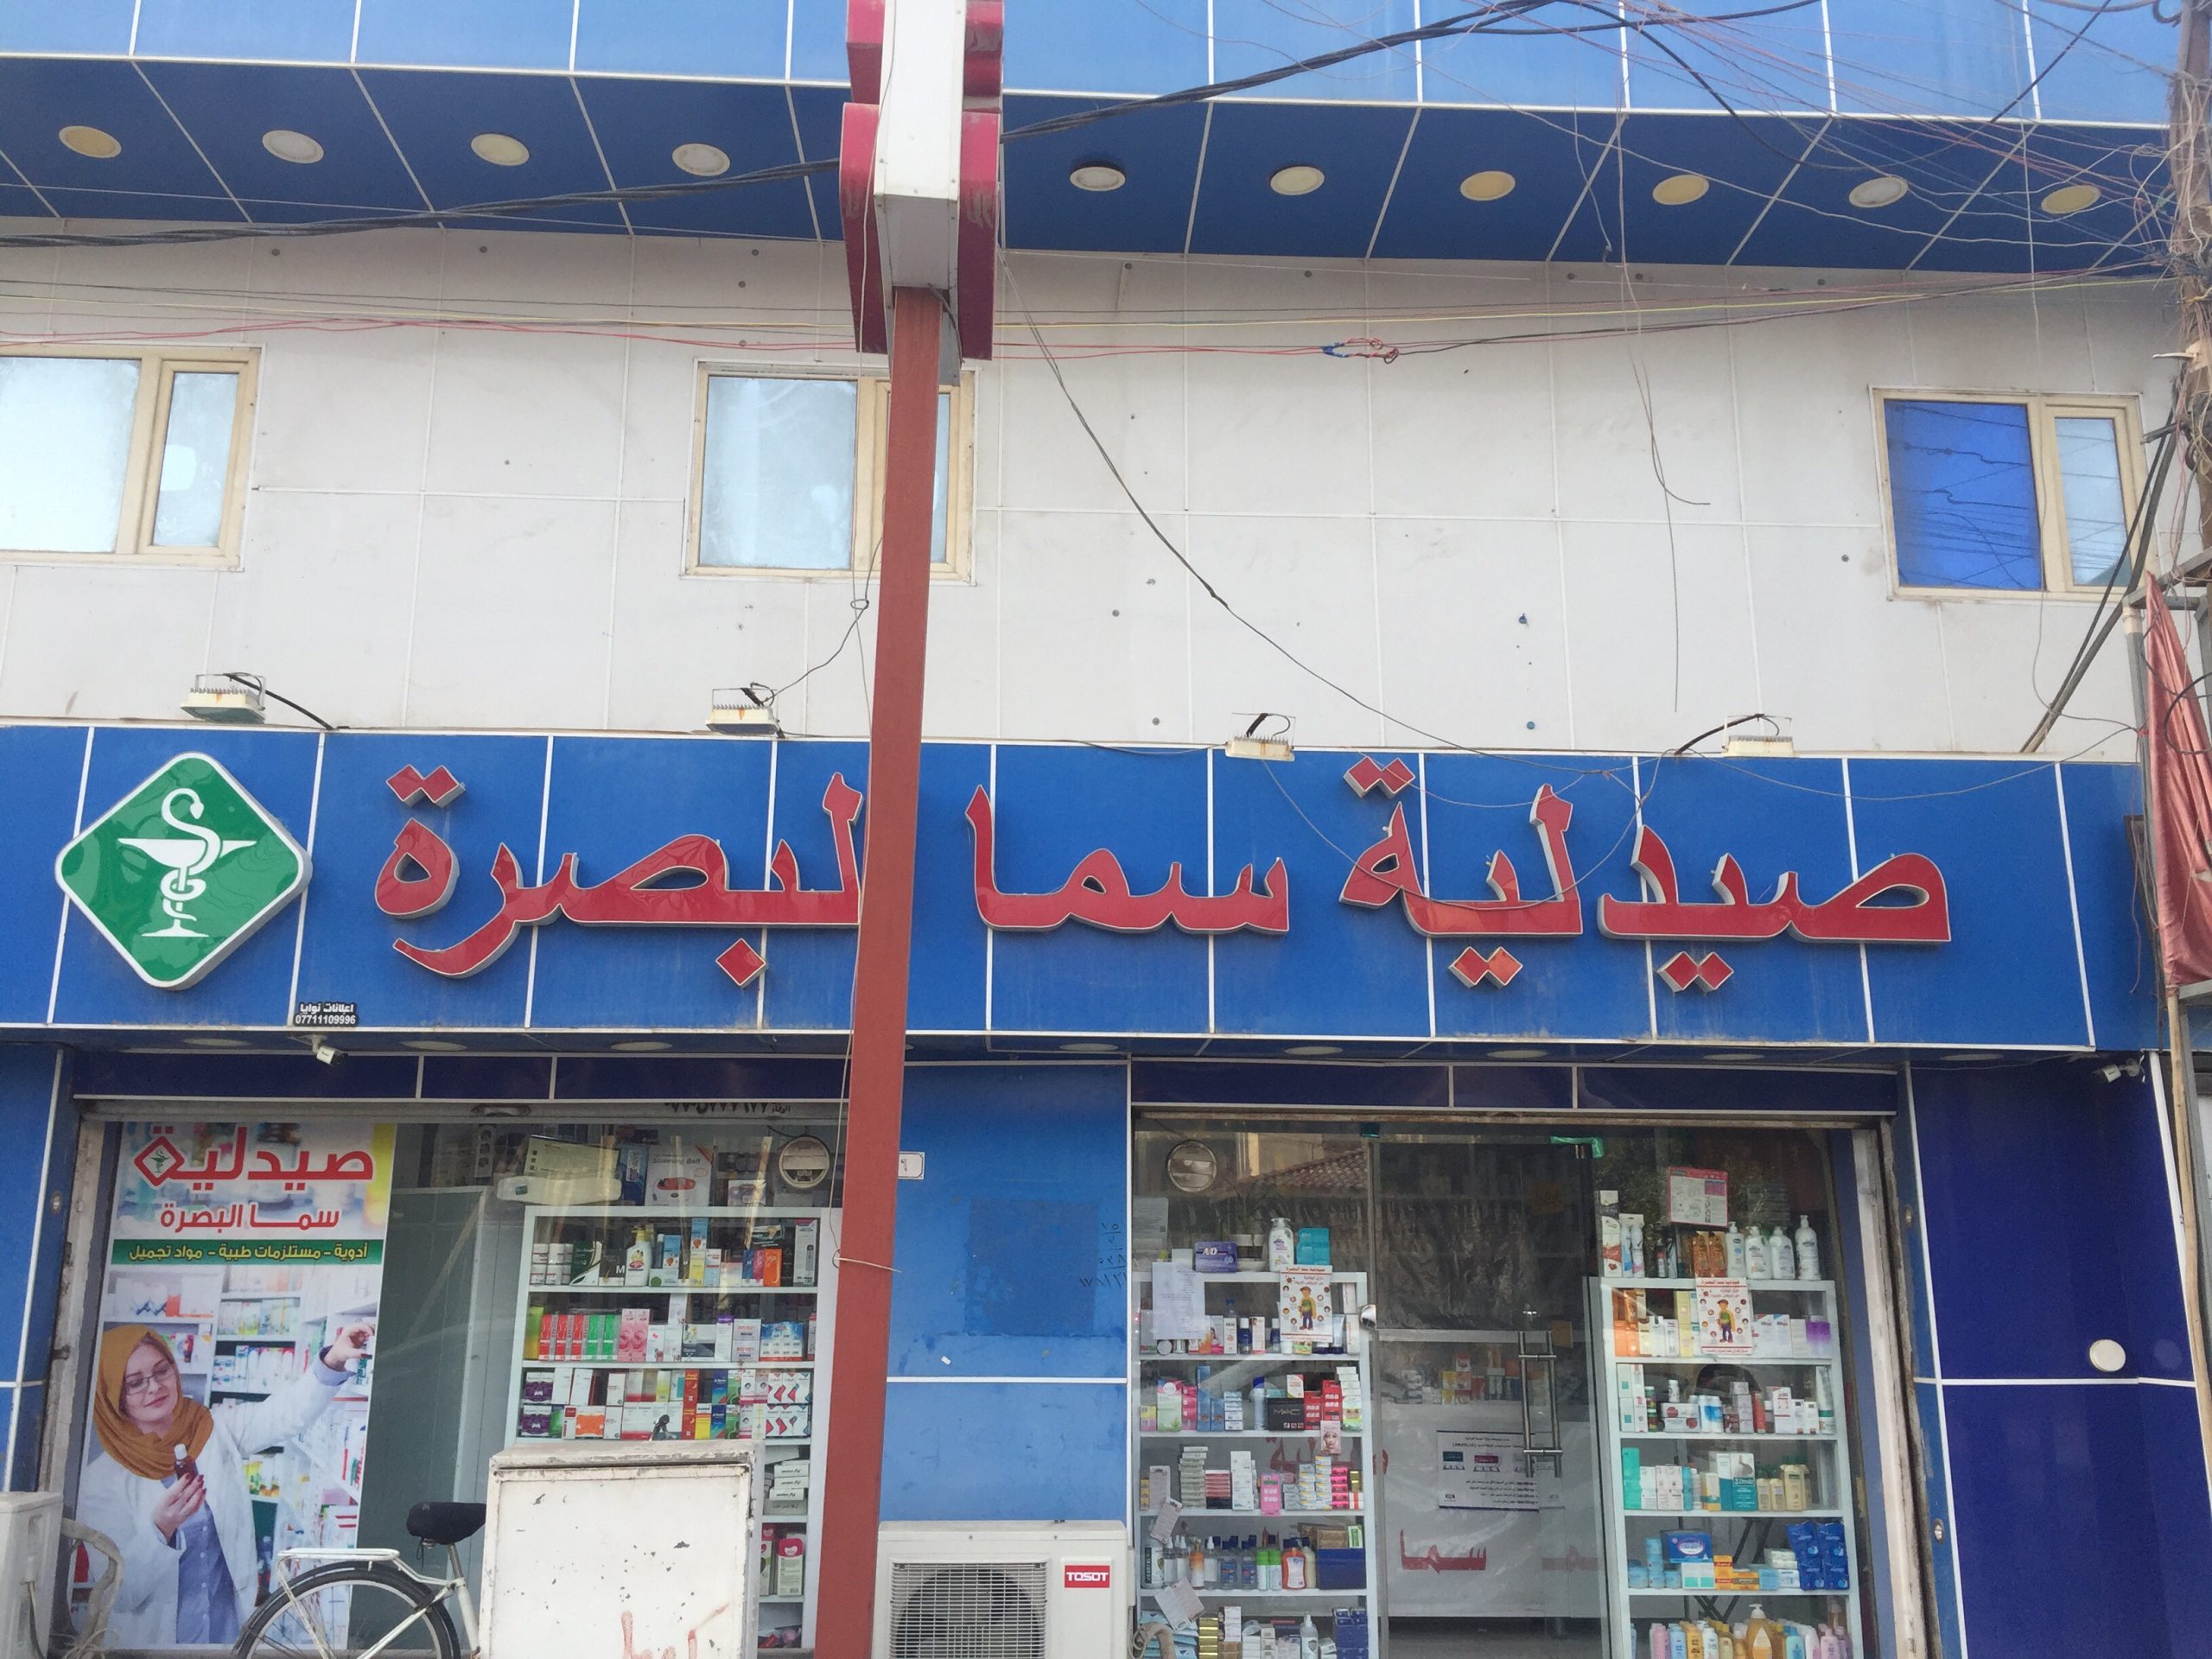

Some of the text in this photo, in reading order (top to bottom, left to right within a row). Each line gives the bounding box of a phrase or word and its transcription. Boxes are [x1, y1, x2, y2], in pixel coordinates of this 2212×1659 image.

[375, 757, 1951, 993] صيدلية سما لبصرة
[296, 1014, 356, 1025] 07711109996
[134, 1126, 373, 1191] صيدلية
[160, 1203, 340, 1233] سما البصرة
[129, 1243, 172, 1261] تجميل
[175, 1245, 203, 1261] مواد
[219, 1243, 251, 1261] طبية
[254, 1244, 321, 1261] مستلزمات
[334, 1243, 368, 1260] أدوية
[1273, 1408, 1300, 1417] MAC
[1400, 1529, 1487, 1574] سما
[1066, 1572, 1109, 1582] TOSOT
